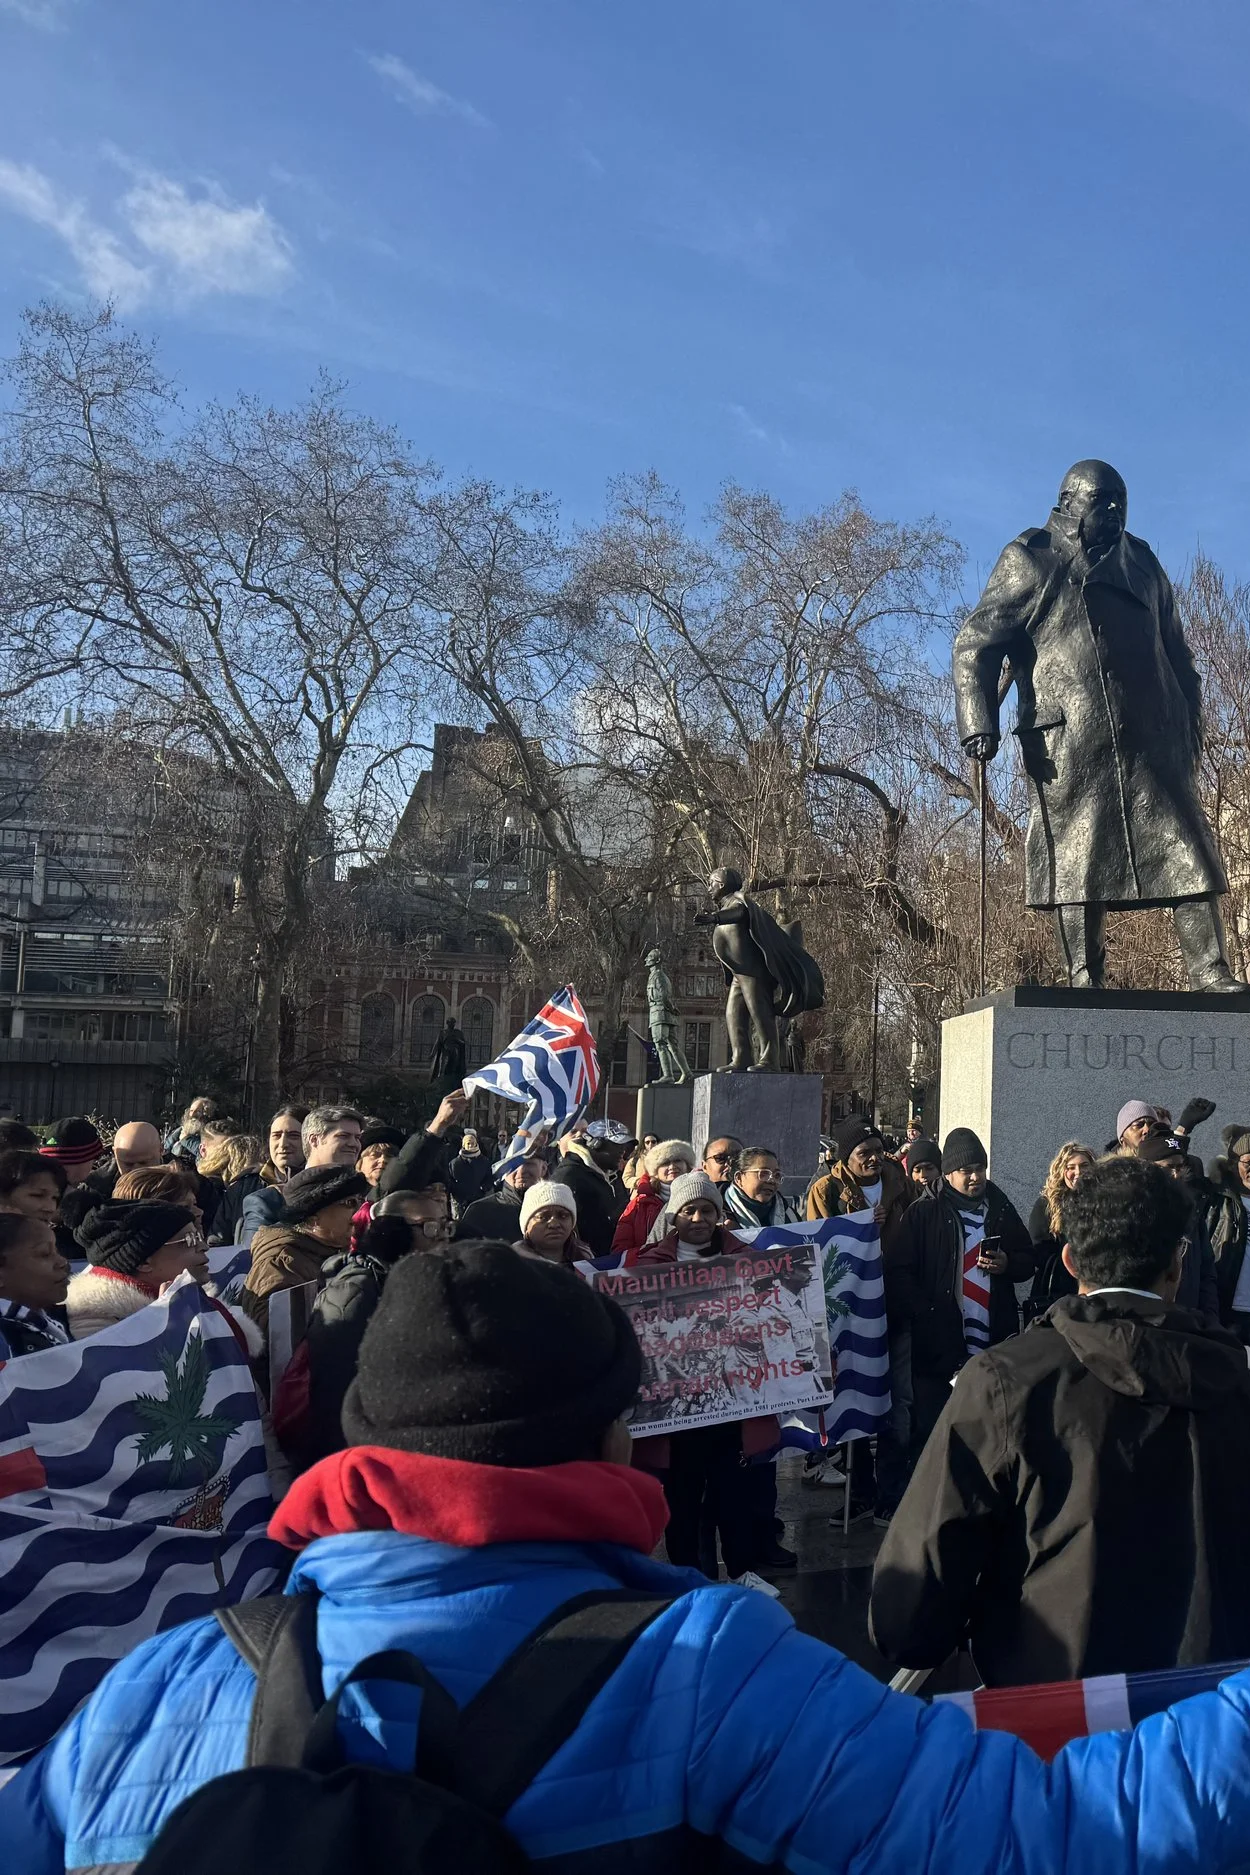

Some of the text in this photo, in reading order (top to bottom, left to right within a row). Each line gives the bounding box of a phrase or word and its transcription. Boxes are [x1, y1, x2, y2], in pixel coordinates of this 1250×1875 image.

[598, 1252, 792, 1296] Mauritian Govt
[688, 1288, 782, 1318] respect
[640, 1320, 789, 1357] hagossians
[638, 1360, 805, 1400] uman rights
[648, 1422, 672, 1430] woman
[693, 1413, 720, 1422] arrested
